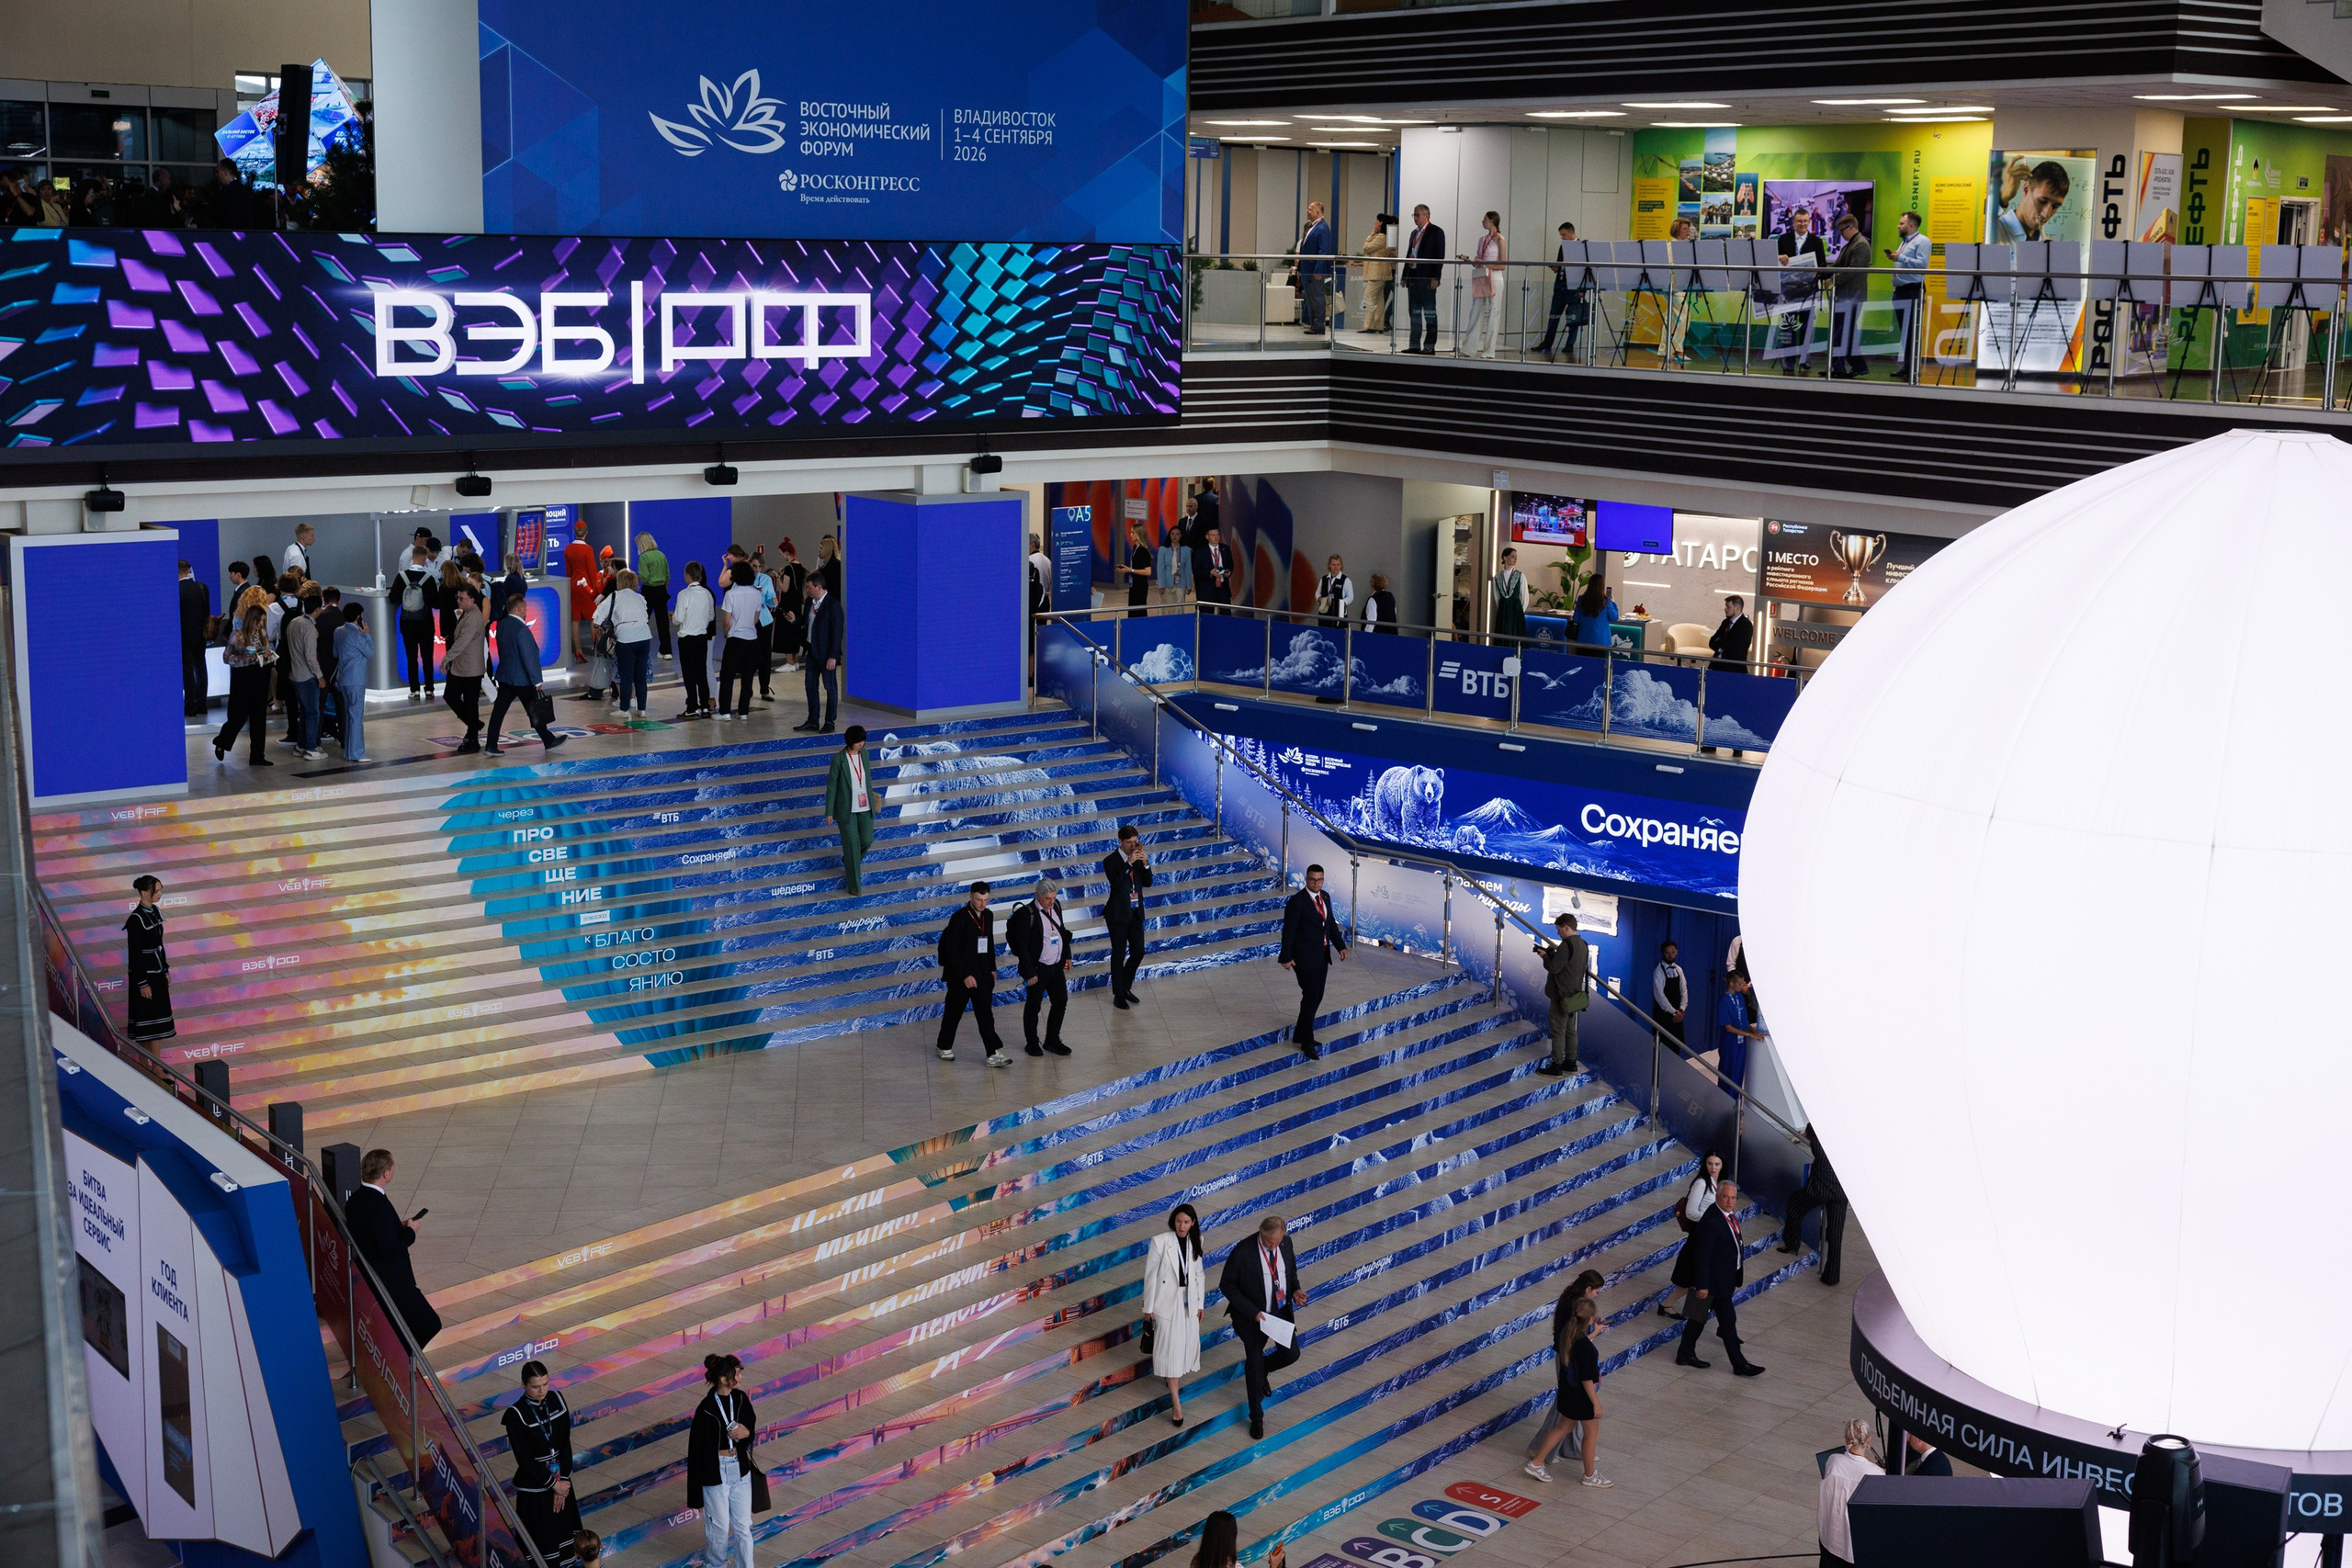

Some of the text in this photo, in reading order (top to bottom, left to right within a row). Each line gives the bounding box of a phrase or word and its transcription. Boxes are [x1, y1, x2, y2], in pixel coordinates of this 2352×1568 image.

[799, 100, 890, 120] ВОСТОЧНЫЙ
[954, 108, 1057, 127] ВЛАДИВОСТОК
[799, 120, 931, 141] ЭКОНОМИЧЕСКИЙ
[984, 130, 1054, 146] СЕНТЯБРЯ
[799, 140, 854, 157] ФОРУМ
[954, 146, 987, 162] 2026
[799, 174, 921, 192] РОСКОНГРЕСС
[1911, 150, 1921, 213] OSNEFT.RU
[799, 193, 870, 204] Время действовать
[1075, 506, 1091, 522] A5
[1782, 523, 1808, 531] Республика
[1767, 551, 1819, 567] 1 МЕСТО
[1886, 562, 1916, 570] Лучший
[1797, 584, 1828, 592] Федерации
[1772, 626, 1837, 644] WELCOME
[1463, 671, 1510, 699] ВТБ
[111, 806, 168, 820] VEB RF
[498, 808, 534, 820] через
[661, 812, 680, 824] ВТБ
[513, 826, 554, 843] ПРО
[1580, 803, 1744, 859] Сохраняе
[528, 846, 568, 863] СВЕ
[682, 850, 736, 865] Сохраняем
[545, 866, 577, 883] ЩЕ
[278, 877, 334, 892] VEB RF
[771, 883, 816, 897] шедевры
[561, 886, 602, 905] НИЕ
[838, 915, 887, 935] природы
[595, 927, 655, 948] БЛАГО
[242, 955, 300, 971] ВЭБ РФ
[612, 948, 676, 969] СОСТО
[815, 948, 834, 961] ВТБ
[97, 980, 124, 991] RF
[628, 971, 684, 992] ЯНИЮ
[184, 1042, 246, 1059] VEB RF
[1087, 1152, 1103, 1167] ВТБ
[84, 1169, 107, 1202] БИТВА
[1192, 1173, 1238, 1198] Сохраняем
[68, 1180, 125, 1241] ЗА ИДЕАЛЬНЫЙ
[84, 1216, 111, 1253] СЕРВИС
[557, 1243, 614, 1267] VEB RF
[161, 1259, 177, 1291] ГОД
[152, 1277, 188, 1323] КЛИЕНТА
[1333, 1313, 1350, 1330] ВТБ
[498, 1337, 559, 1367] ВЭБ РФ
[1860, 1352, 1955, 1440] ПОДЪЕМНАЯ
[1961, 1424, 2035, 1471] СИЛА
[1323, 1491, 1365, 1521] ВЭБ РФ
[1479, 1494, 1502, 1514] S
[668, 1509, 695, 1527] VEB
[1436, 1510, 1501, 1539] D
[1411, 1526, 1473, 1552] C
[1368, 1547, 1436, 1568] B
